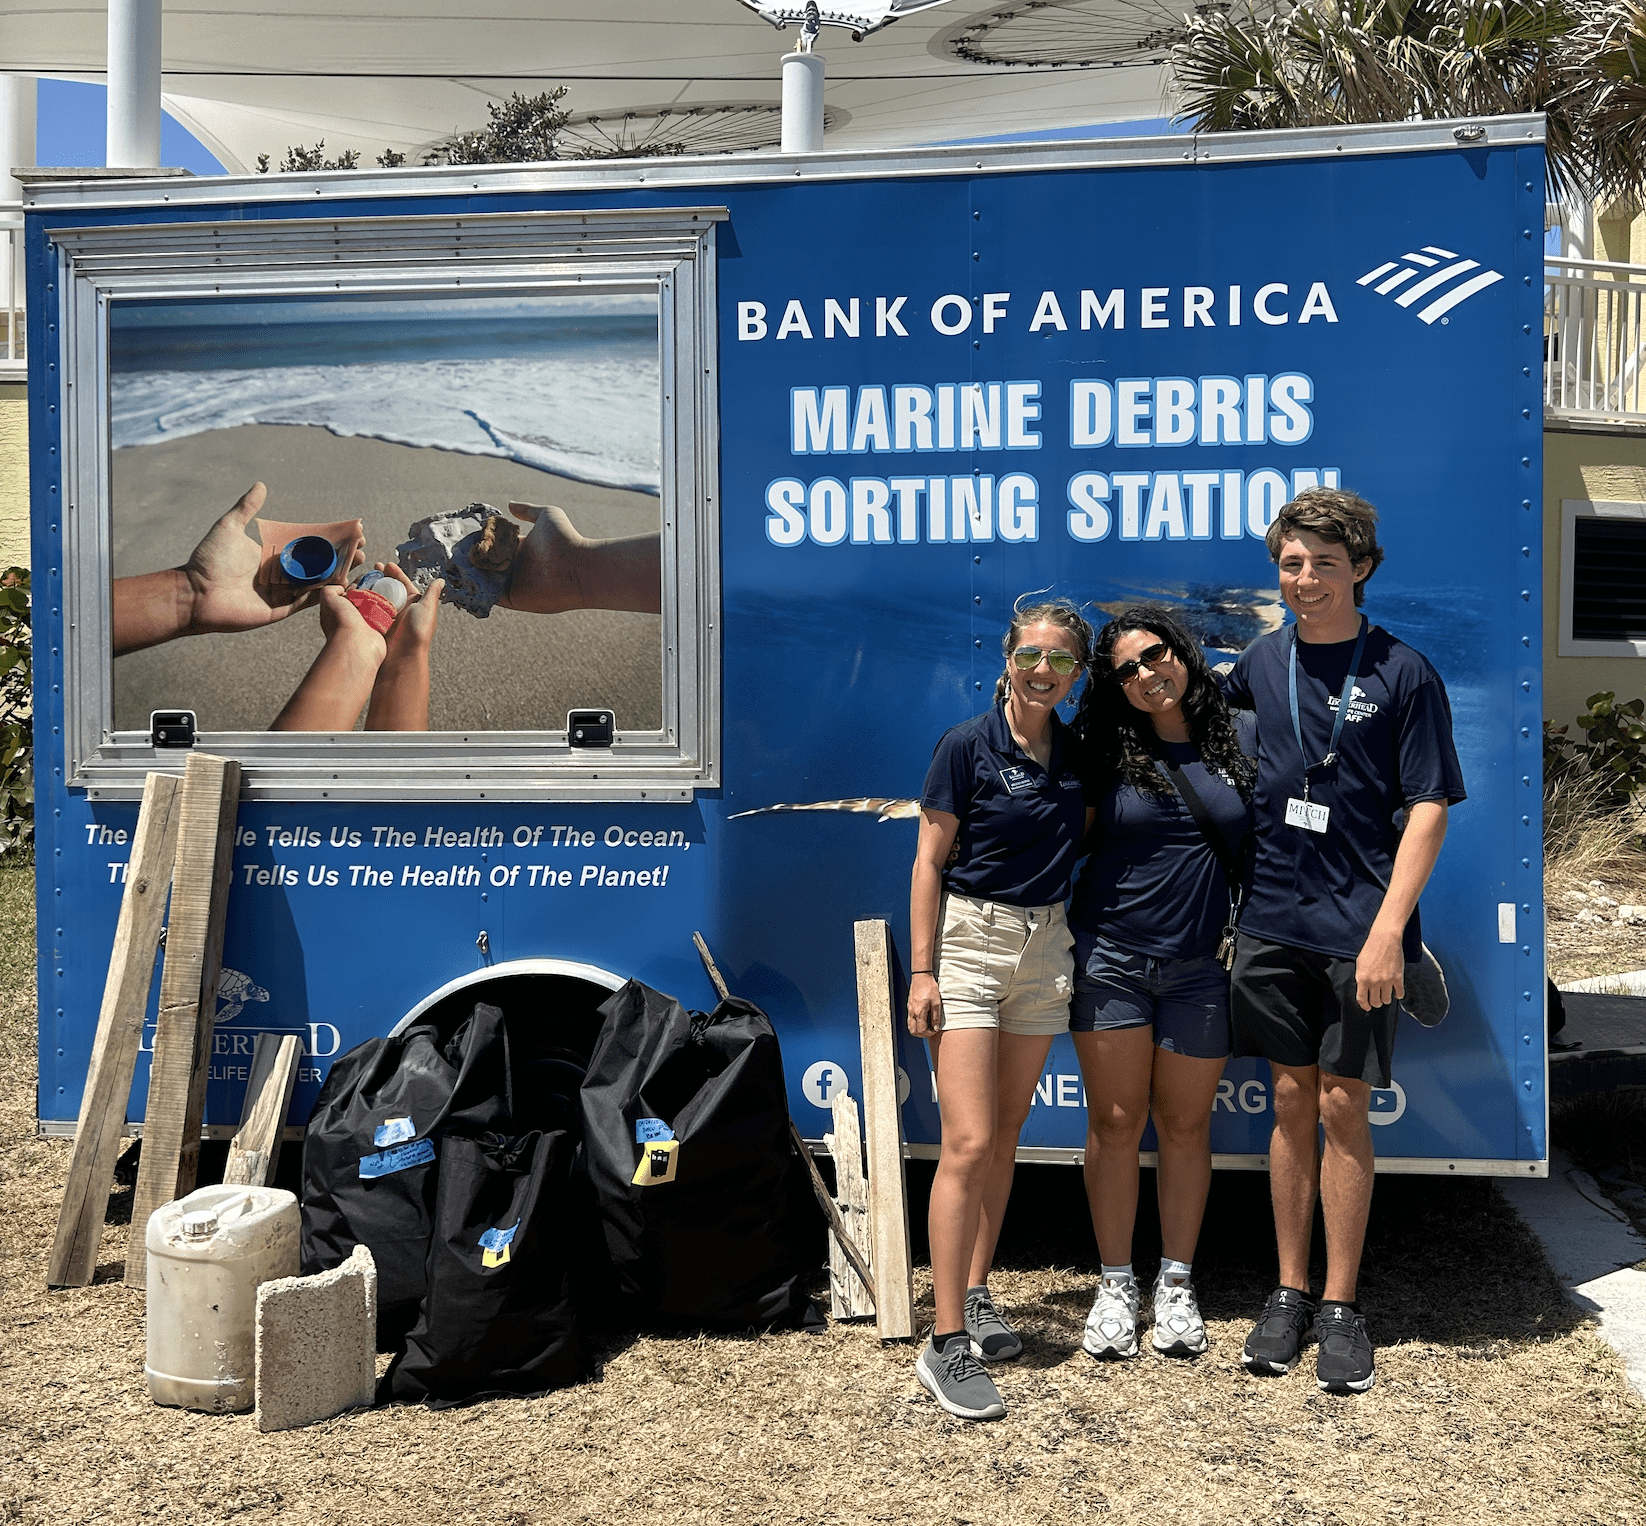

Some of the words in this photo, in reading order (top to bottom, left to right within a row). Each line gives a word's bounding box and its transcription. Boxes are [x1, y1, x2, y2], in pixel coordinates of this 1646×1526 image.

[737, 296, 909, 341] BANK
[930, 292, 1011, 336] OF
[1028, 282, 1339, 332] AMERICA
[791, 380, 1041, 454] MARINE
[1070, 373, 1313, 448] DEBRIS
[765, 473, 1038, 546] SORTING
[84, 824, 128, 846] The
[265, 826, 322, 848] Tells
[329, 826, 362, 848] Us
[371, 826, 417, 848] The
[423, 826, 504, 848] Health
[512, 825, 545, 848] Of
[550, 825, 596, 848] The
[603, 825, 691, 851] Ocean,
[243, 864, 300, 886] Tells
[307, 864, 340, 887] Us
[348, 865, 394, 887] The
[400, 865, 482, 887] Health
[489, 864, 522, 887] Of
[526, 865, 573, 887] The
[579, 865, 670, 887] Planet!
